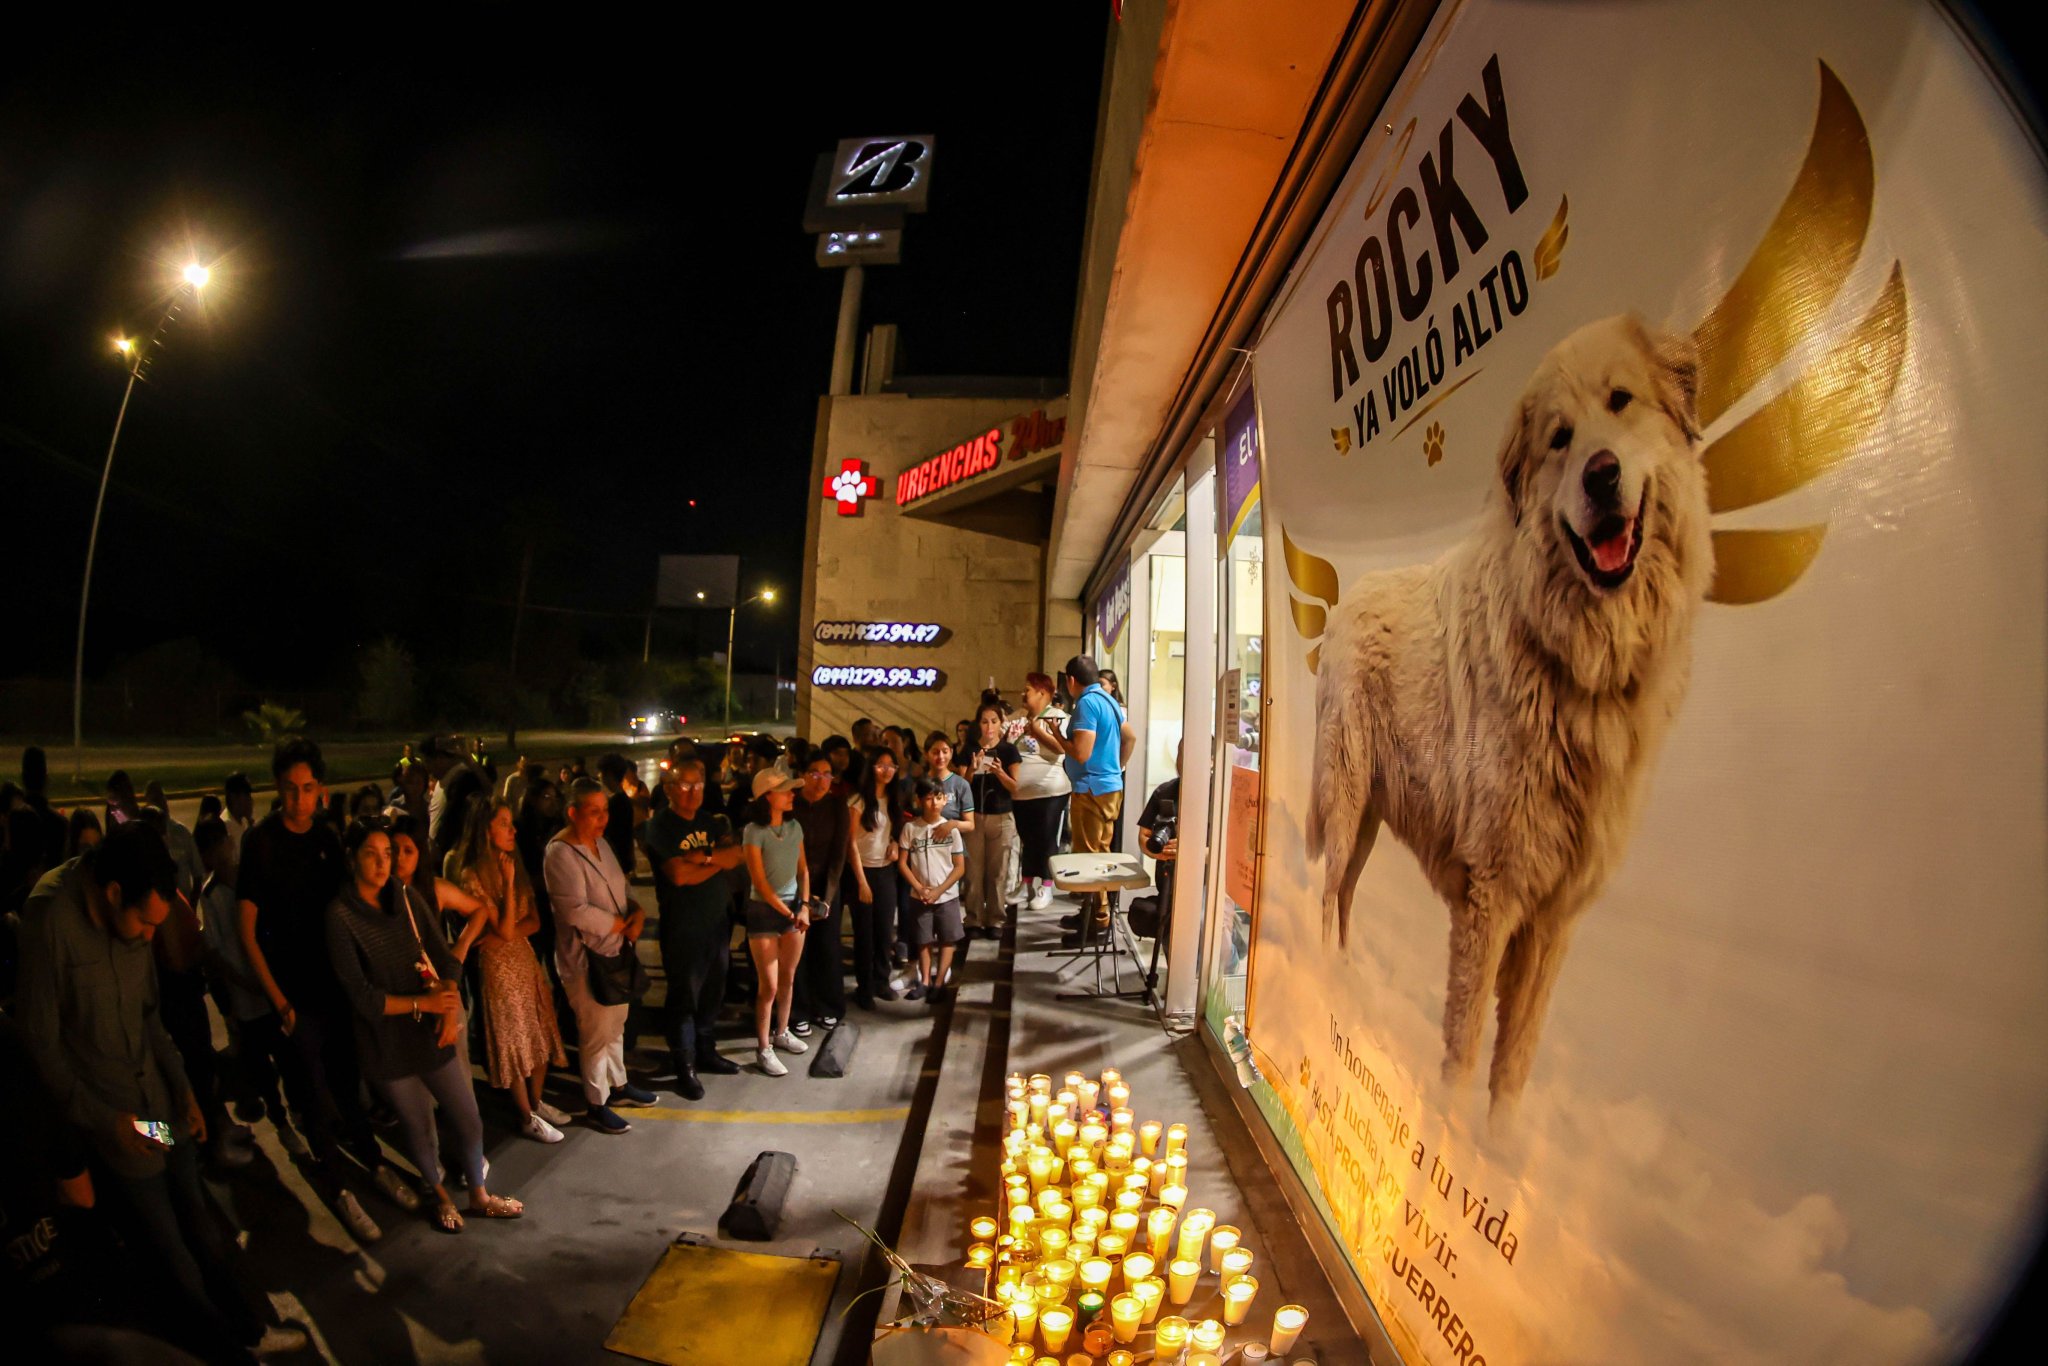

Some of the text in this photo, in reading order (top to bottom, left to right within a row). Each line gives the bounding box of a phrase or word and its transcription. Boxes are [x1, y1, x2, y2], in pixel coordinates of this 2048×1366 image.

[1327, 53, 1529, 402] ROCKY
[1353, 250, 1529, 449] YA VOLÓ ALTO
[896, 428, 1000, 506] URGENCIAS
[1330, 1014, 1519, 1266] Un homenaje a tu vida
[1334, 1085, 1458, 1280] y lucha por vivir.
